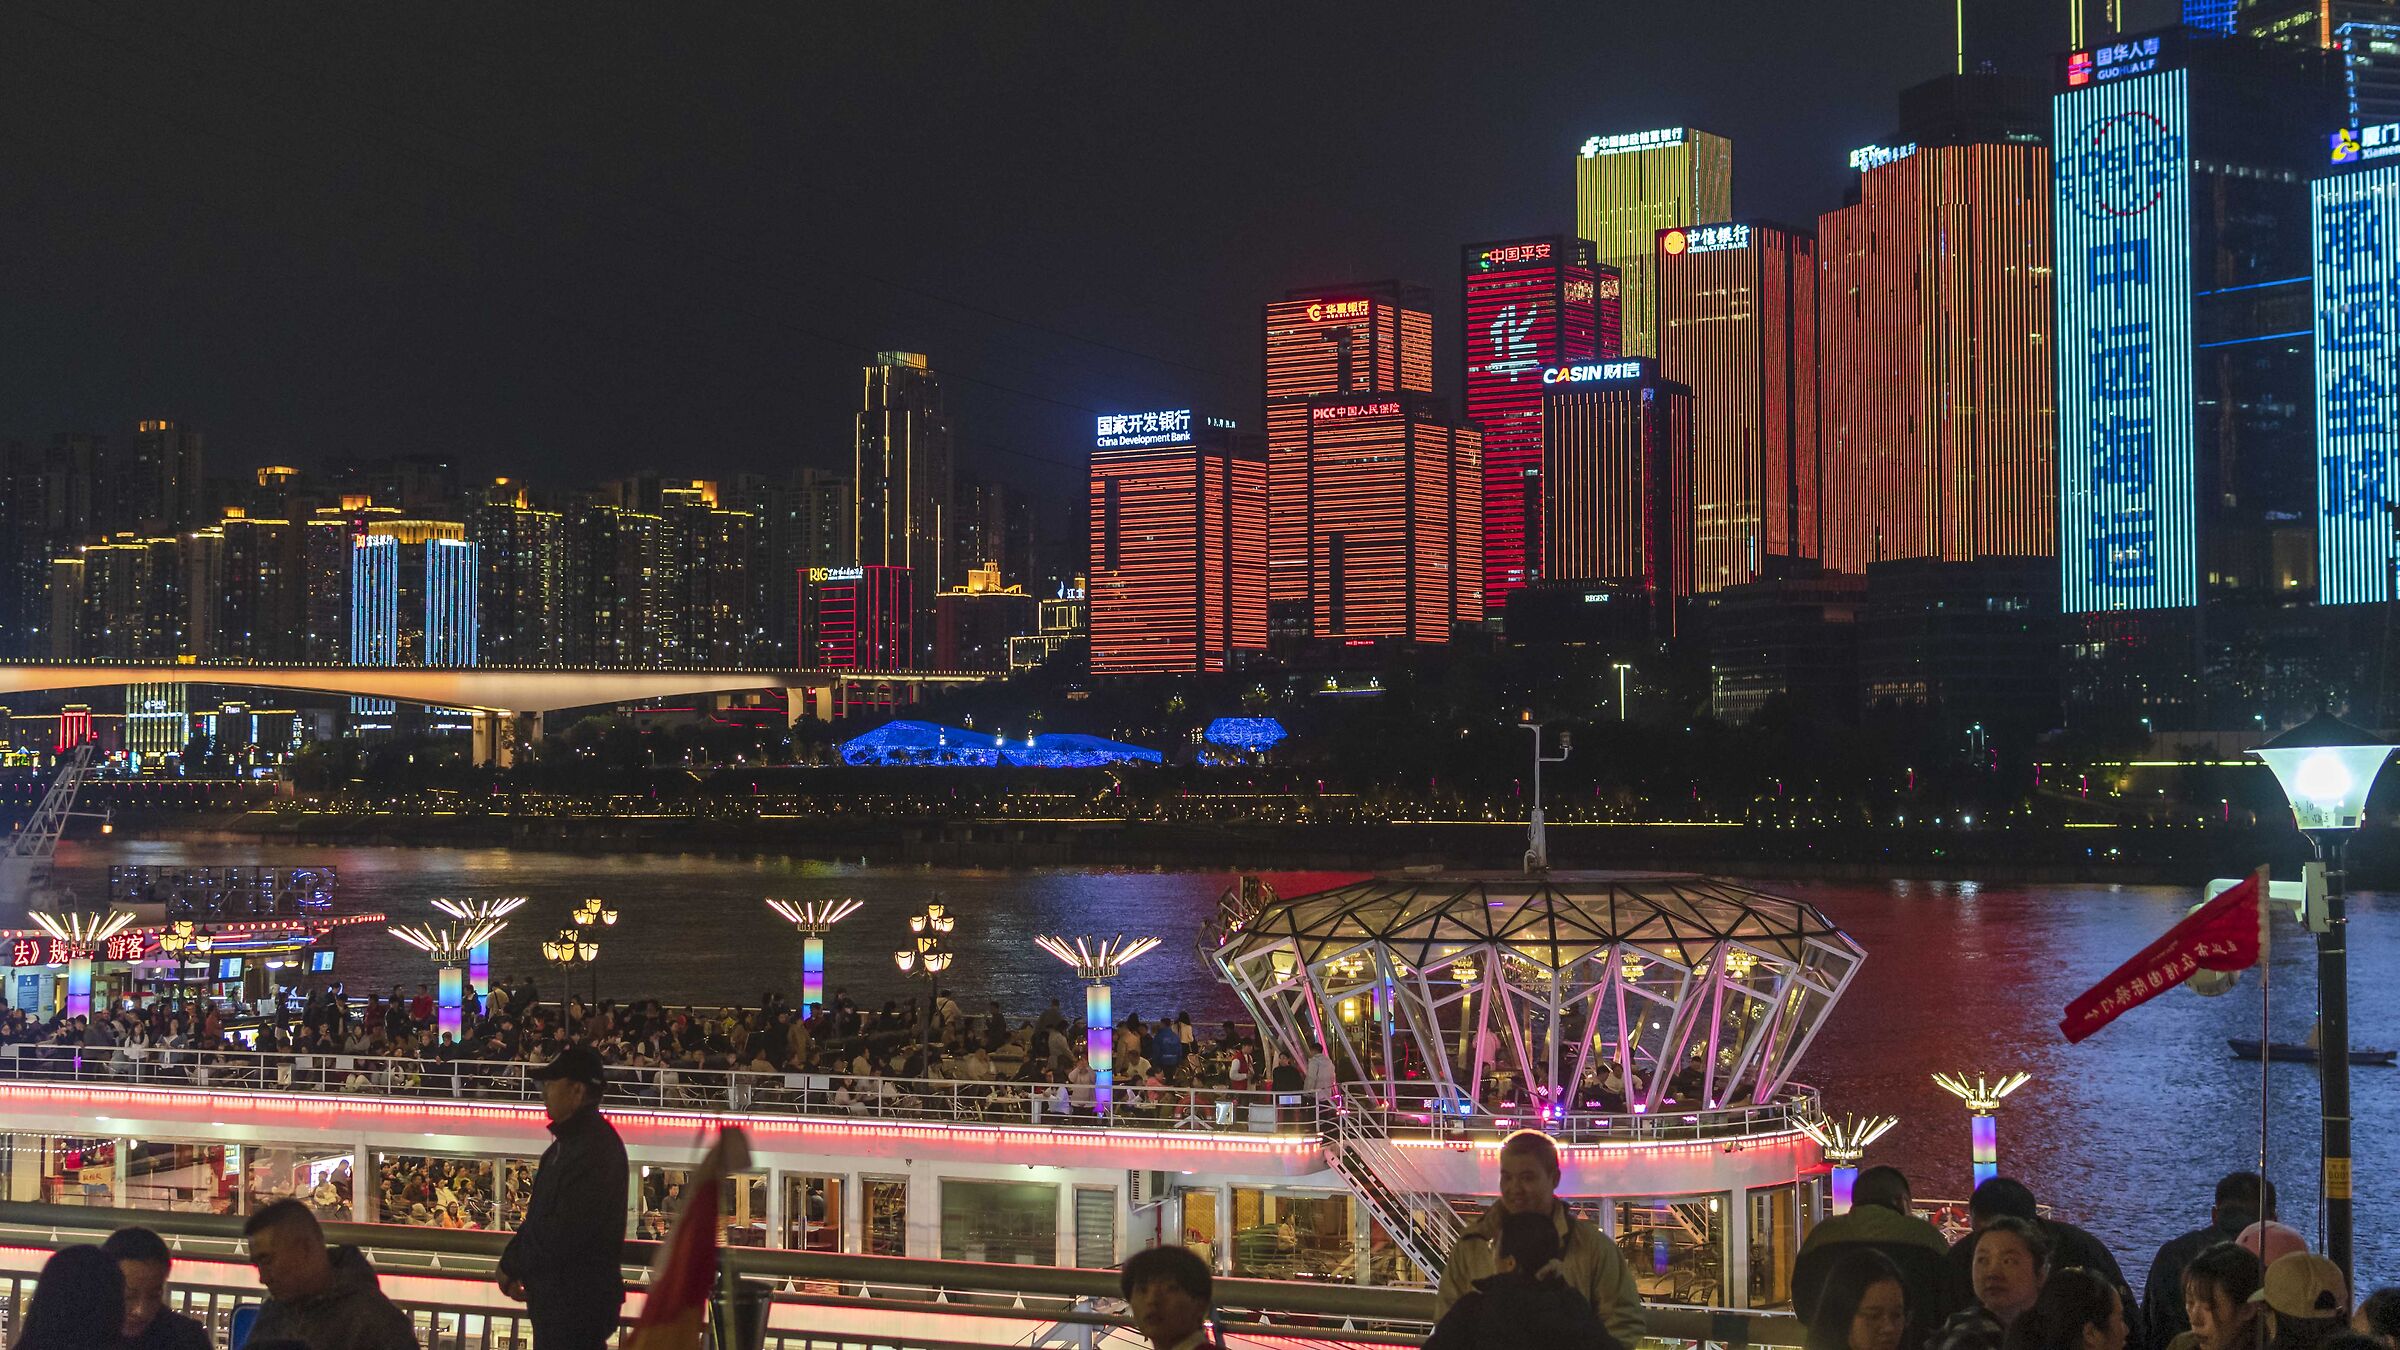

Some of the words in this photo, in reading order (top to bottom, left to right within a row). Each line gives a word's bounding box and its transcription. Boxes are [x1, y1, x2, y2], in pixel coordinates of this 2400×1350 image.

[2096, 37, 2160, 66] 国华人寿
[2097, 62, 2139, 80] GUOHUA
[1686, 224, 1750, 247] 中信银行
[1490, 244, 1551, 264] 中国平安
[1687, 245, 1709, 254] CHINA
[1709, 243, 1728, 252] CITIC
[1728, 240, 1748, 250] BANK
[1326, 300, 1369, 315] 华夏银行
[1543, 365, 1602, 384] CASIN
[1604, 362, 1640, 379] 财信
[1313, 407, 1336, 419] PICC
[1337, 402, 1400, 417] 中国人民保险
[2089, 227, 2155, 588] 中远海运
[1097, 409, 1190, 436] 国家开发银行
[1097, 436, 1118, 447] China
[1119, 433, 1170, 445] Development
[1171, 430, 1190, 442] Bank
[809, 567, 828, 581] RIG
[1585, 594, 1609, 602] REGENT
